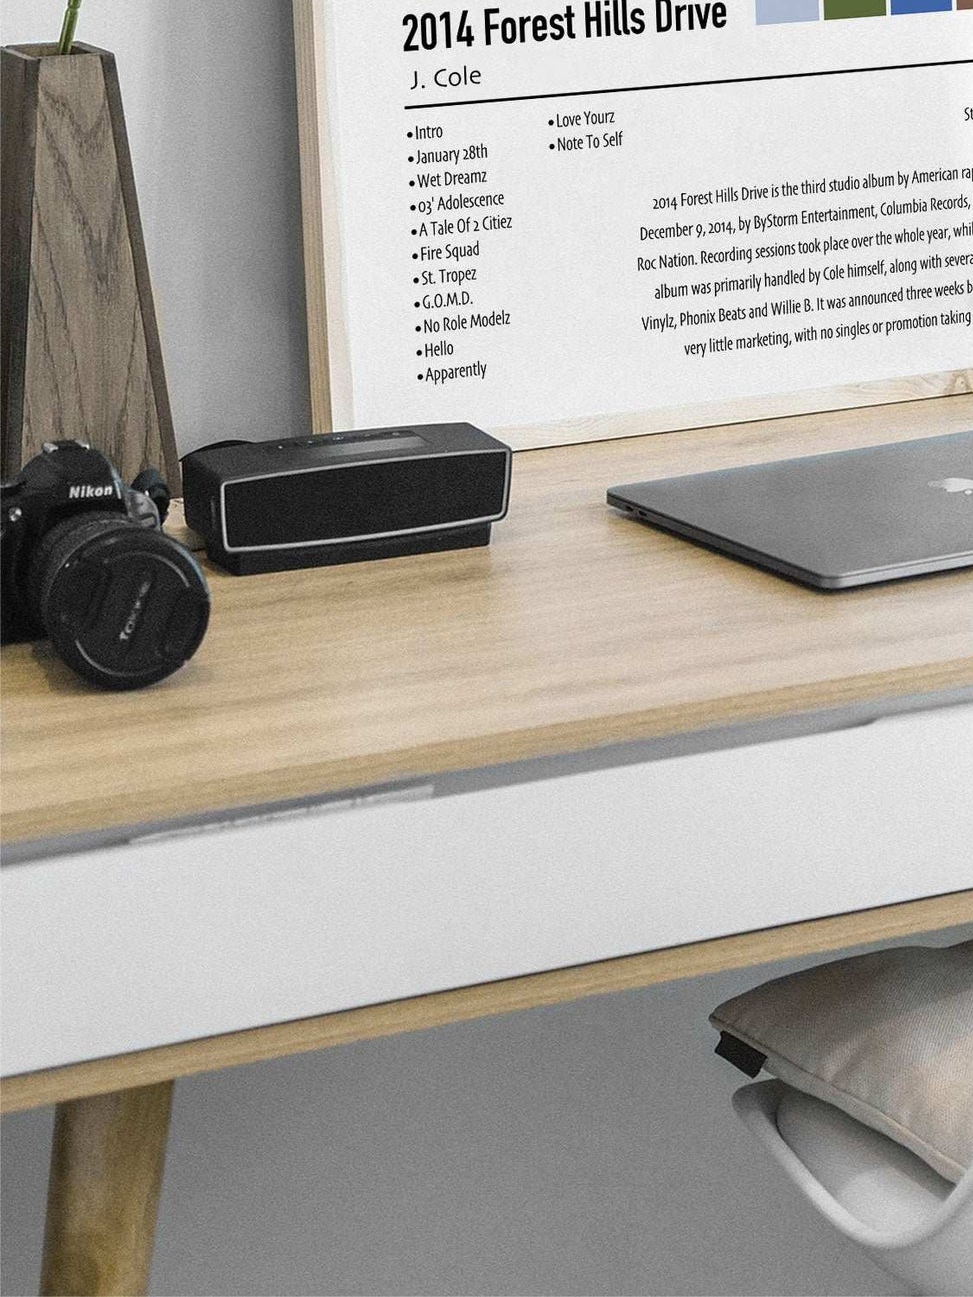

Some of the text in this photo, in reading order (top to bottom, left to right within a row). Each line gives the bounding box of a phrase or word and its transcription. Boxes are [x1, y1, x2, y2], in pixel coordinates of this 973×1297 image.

[402, 10, 475, 52] 2014
[484, 5, 576, 46] Forest
[584, 0, 645, 38] Hills
[410, 65, 481, 90] J. Cole
[556, 111, 615, 128] Love Yourz
[415, 125, 443, 140] Intro
[557, 130, 623, 151] Note To Self
[416, 143, 488, 165] January 28th
[417, 171, 487, 188] Wet Dreamz
[653, 197, 678, 210] 2014
[681, 191, 713, 207] Forest
[716, 187, 739, 203] Hills
[741, 186, 768, 201] Drive
[771, 184, 779, 198] is
[781, 182, 798, 197] the
[801, 178, 826, 195] third
[829, 176, 860, 192] studio
[862, 173, 894, 189] album
[897, 171, 909, 189] by
[911, 168, 958, 184] American
[437, 193, 504, 211] Adolescence
[419, 215, 512, 237] A Tale Of 2 Citiez
[640, 222, 694, 241] December
[696, 224, 706, 238] 9,
[708, 221, 736, 235] 2014,
[738, 216, 751, 234] by
[754, 213, 798, 232] ByStorm
[801, 205, 878, 224] Entertainment,
[880, 198, 927, 216] Columbia
[930, 194, 971, 211] Records,
[421, 240, 479, 262] Fire Squad
[637, 257, 656, 271] Roc
[659, 253, 698, 269] Nation.
[701, 246, 752, 264] Recording
[755, 243, 796, 259] sessions
[798, 238, 821, 254] took
[823, 236, 849, 255] place
[851, 236, 874, 249] over
[875, 231, 892, 246] the
[894, 227, 925, 244] whole
[926, 228, 951, 244] year,
[421, 269, 477, 286] St. Tropez
[654, 283, 688, 299] album
[691, 282, 711, 295] was
[714, 274, 762, 297] primarily
[764, 268, 805, 287] handled
[809, 268, 821, 286] by
[823, 265, 845, 280] Cole
[847, 259, 887, 278] himself,
[889, 259, 917, 275] along
[920, 254, 942, 270] with
[422, 291, 473, 309] G.O.M.D.
[641, 313, 677, 333] Vinylz,
[680, 309, 716, 326] Phonix
[718, 307, 746, 322] Beats
[749, 302, 768, 319] and
[771, 299, 801, 316] Willie
[804, 298, 814, 312] B.
[817, 298, 825, 311] It
[826, 297, 846, 309] was
[848, 287, 903, 307] announced
[906, 286, 932, 300] three
[934, 281, 964, 297] weeks
[424, 310, 510, 334] No Role Modelz
[684, 343, 707, 358] very
[709, 336, 733, 353] little
[736, 331, 792, 349] marketing,
[794, 326, 817, 342] with
[821, 328, 833, 340] no
[835, 321, 870, 340] singles
[872, 322, 883, 334] or
[886, 314, 938, 336] promotion
[940, 310, 971, 327] taking
[425, 340, 454, 358] Hello
[425, 360, 487, 385] Apparently
[68, 485, 113, 499] Nikon
